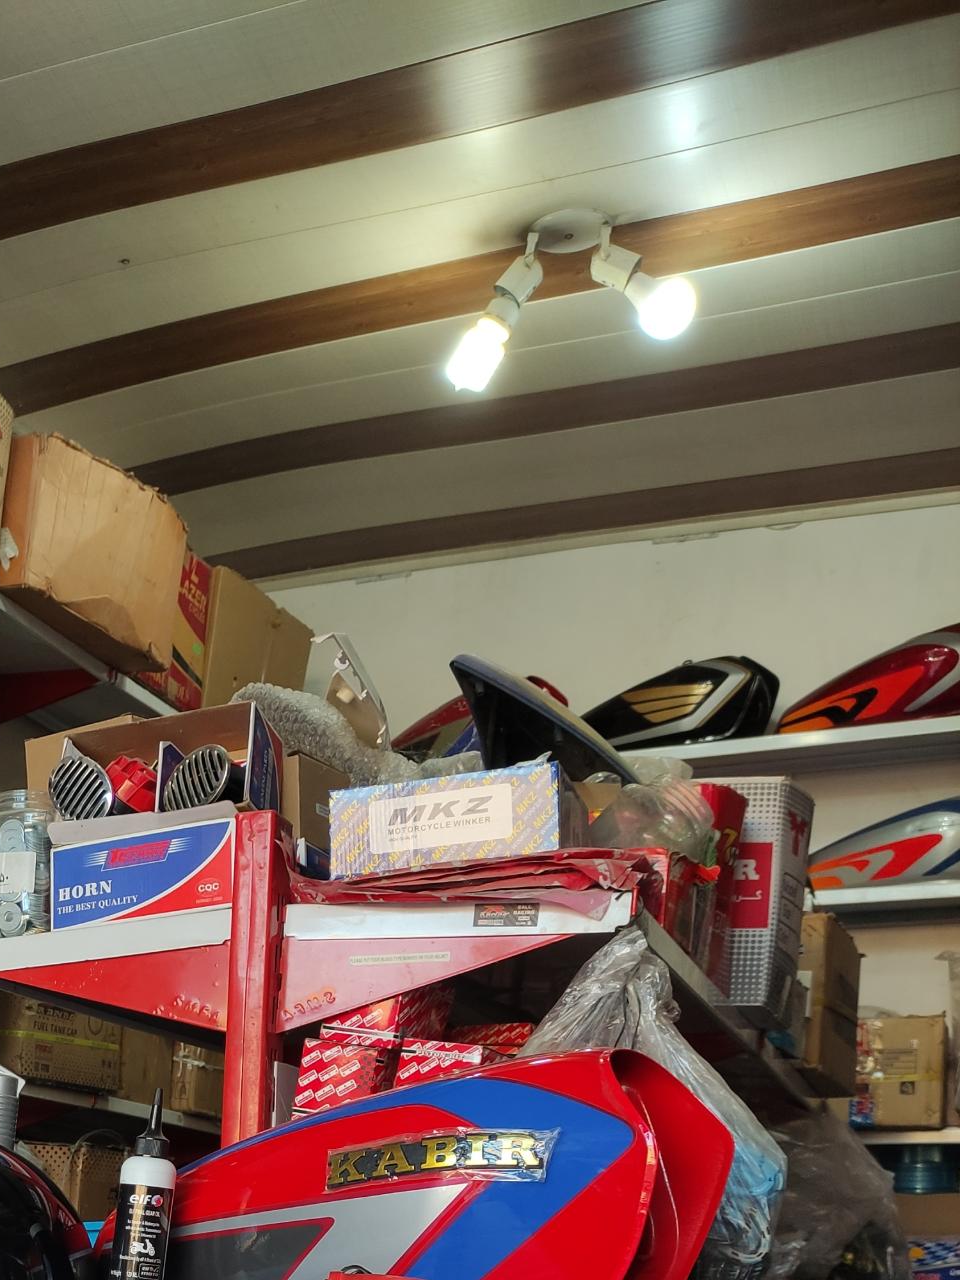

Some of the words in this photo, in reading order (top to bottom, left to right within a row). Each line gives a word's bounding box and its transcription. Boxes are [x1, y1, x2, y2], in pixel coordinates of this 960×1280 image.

[387, 795, 493, 827] MKZ
[386, 821, 453, 837] MOTORCYCLE
[452, 815, 493, 827] WINKER
[57, 879, 113, 903] HORN
[196, 881, 221, 893] CQC
[57, 904, 74, 916] THE
[75, 901, 98, 912] BEST
[97, 894, 139, 910] QUALITY
[328, 1131, 544, 1188] KABIR
[129, 1194, 152, 1205] elf
